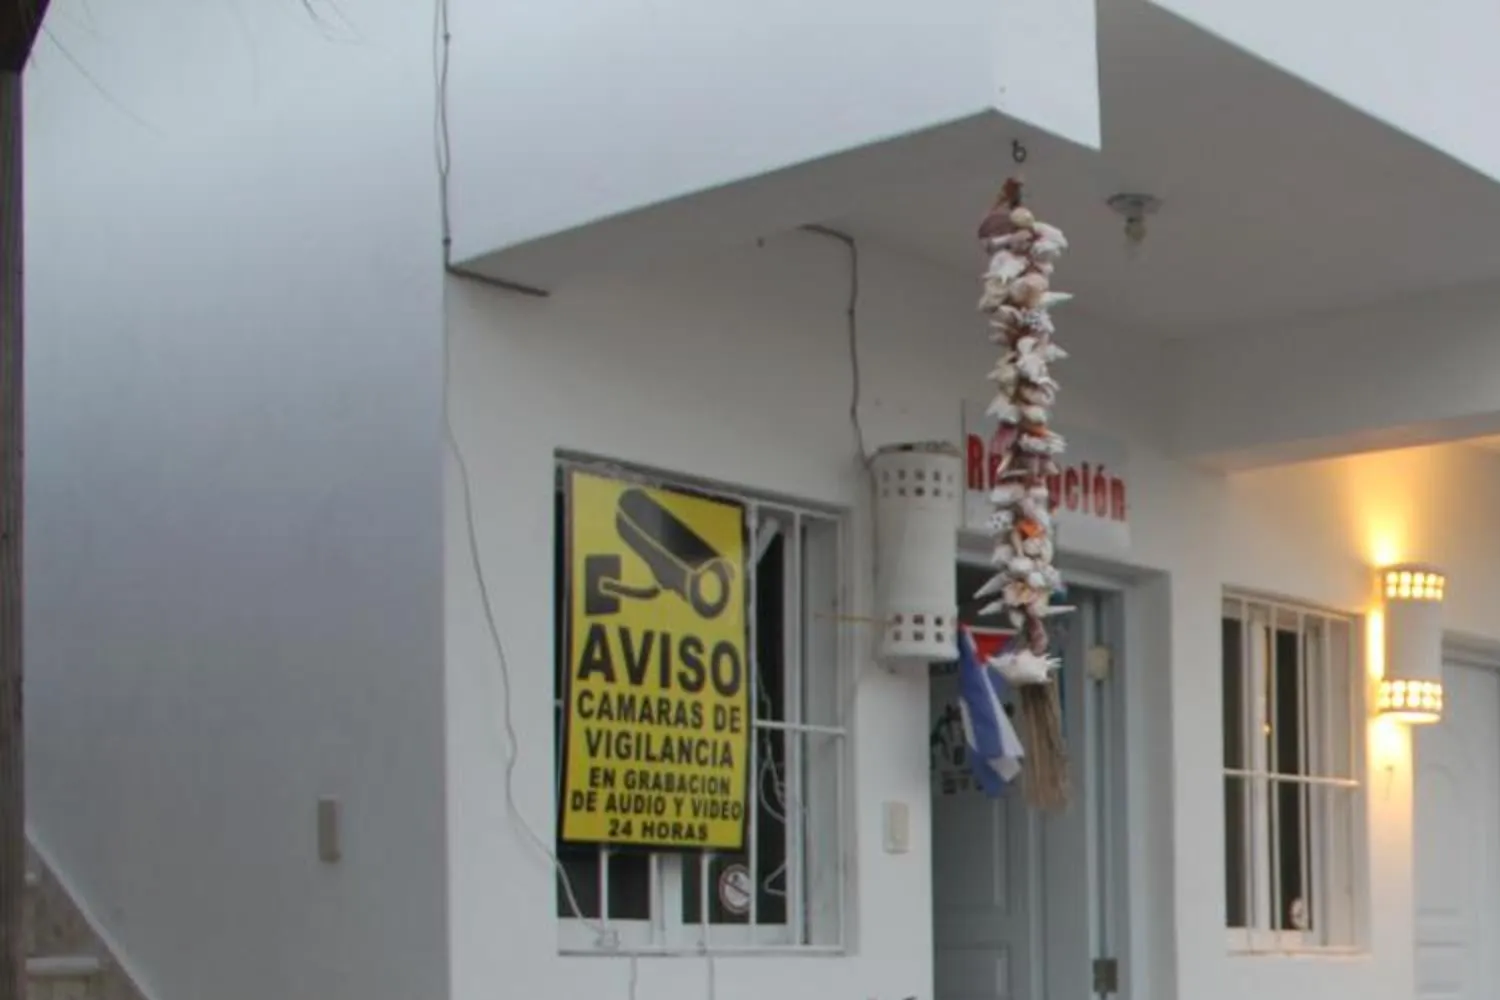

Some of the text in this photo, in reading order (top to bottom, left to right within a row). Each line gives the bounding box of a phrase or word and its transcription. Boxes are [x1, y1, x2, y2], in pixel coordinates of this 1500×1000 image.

[577, 623, 741, 697] AVISO
[577, 689, 742, 734] CAMARAS DE
[585, 727, 734, 769] VIGILANCIA
[589, 767, 731, 795] EN GRABACION
[571, 789, 744, 821] DE AUDIO Y VIDEO
[608, 818, 709, 841] 24 HORAS
